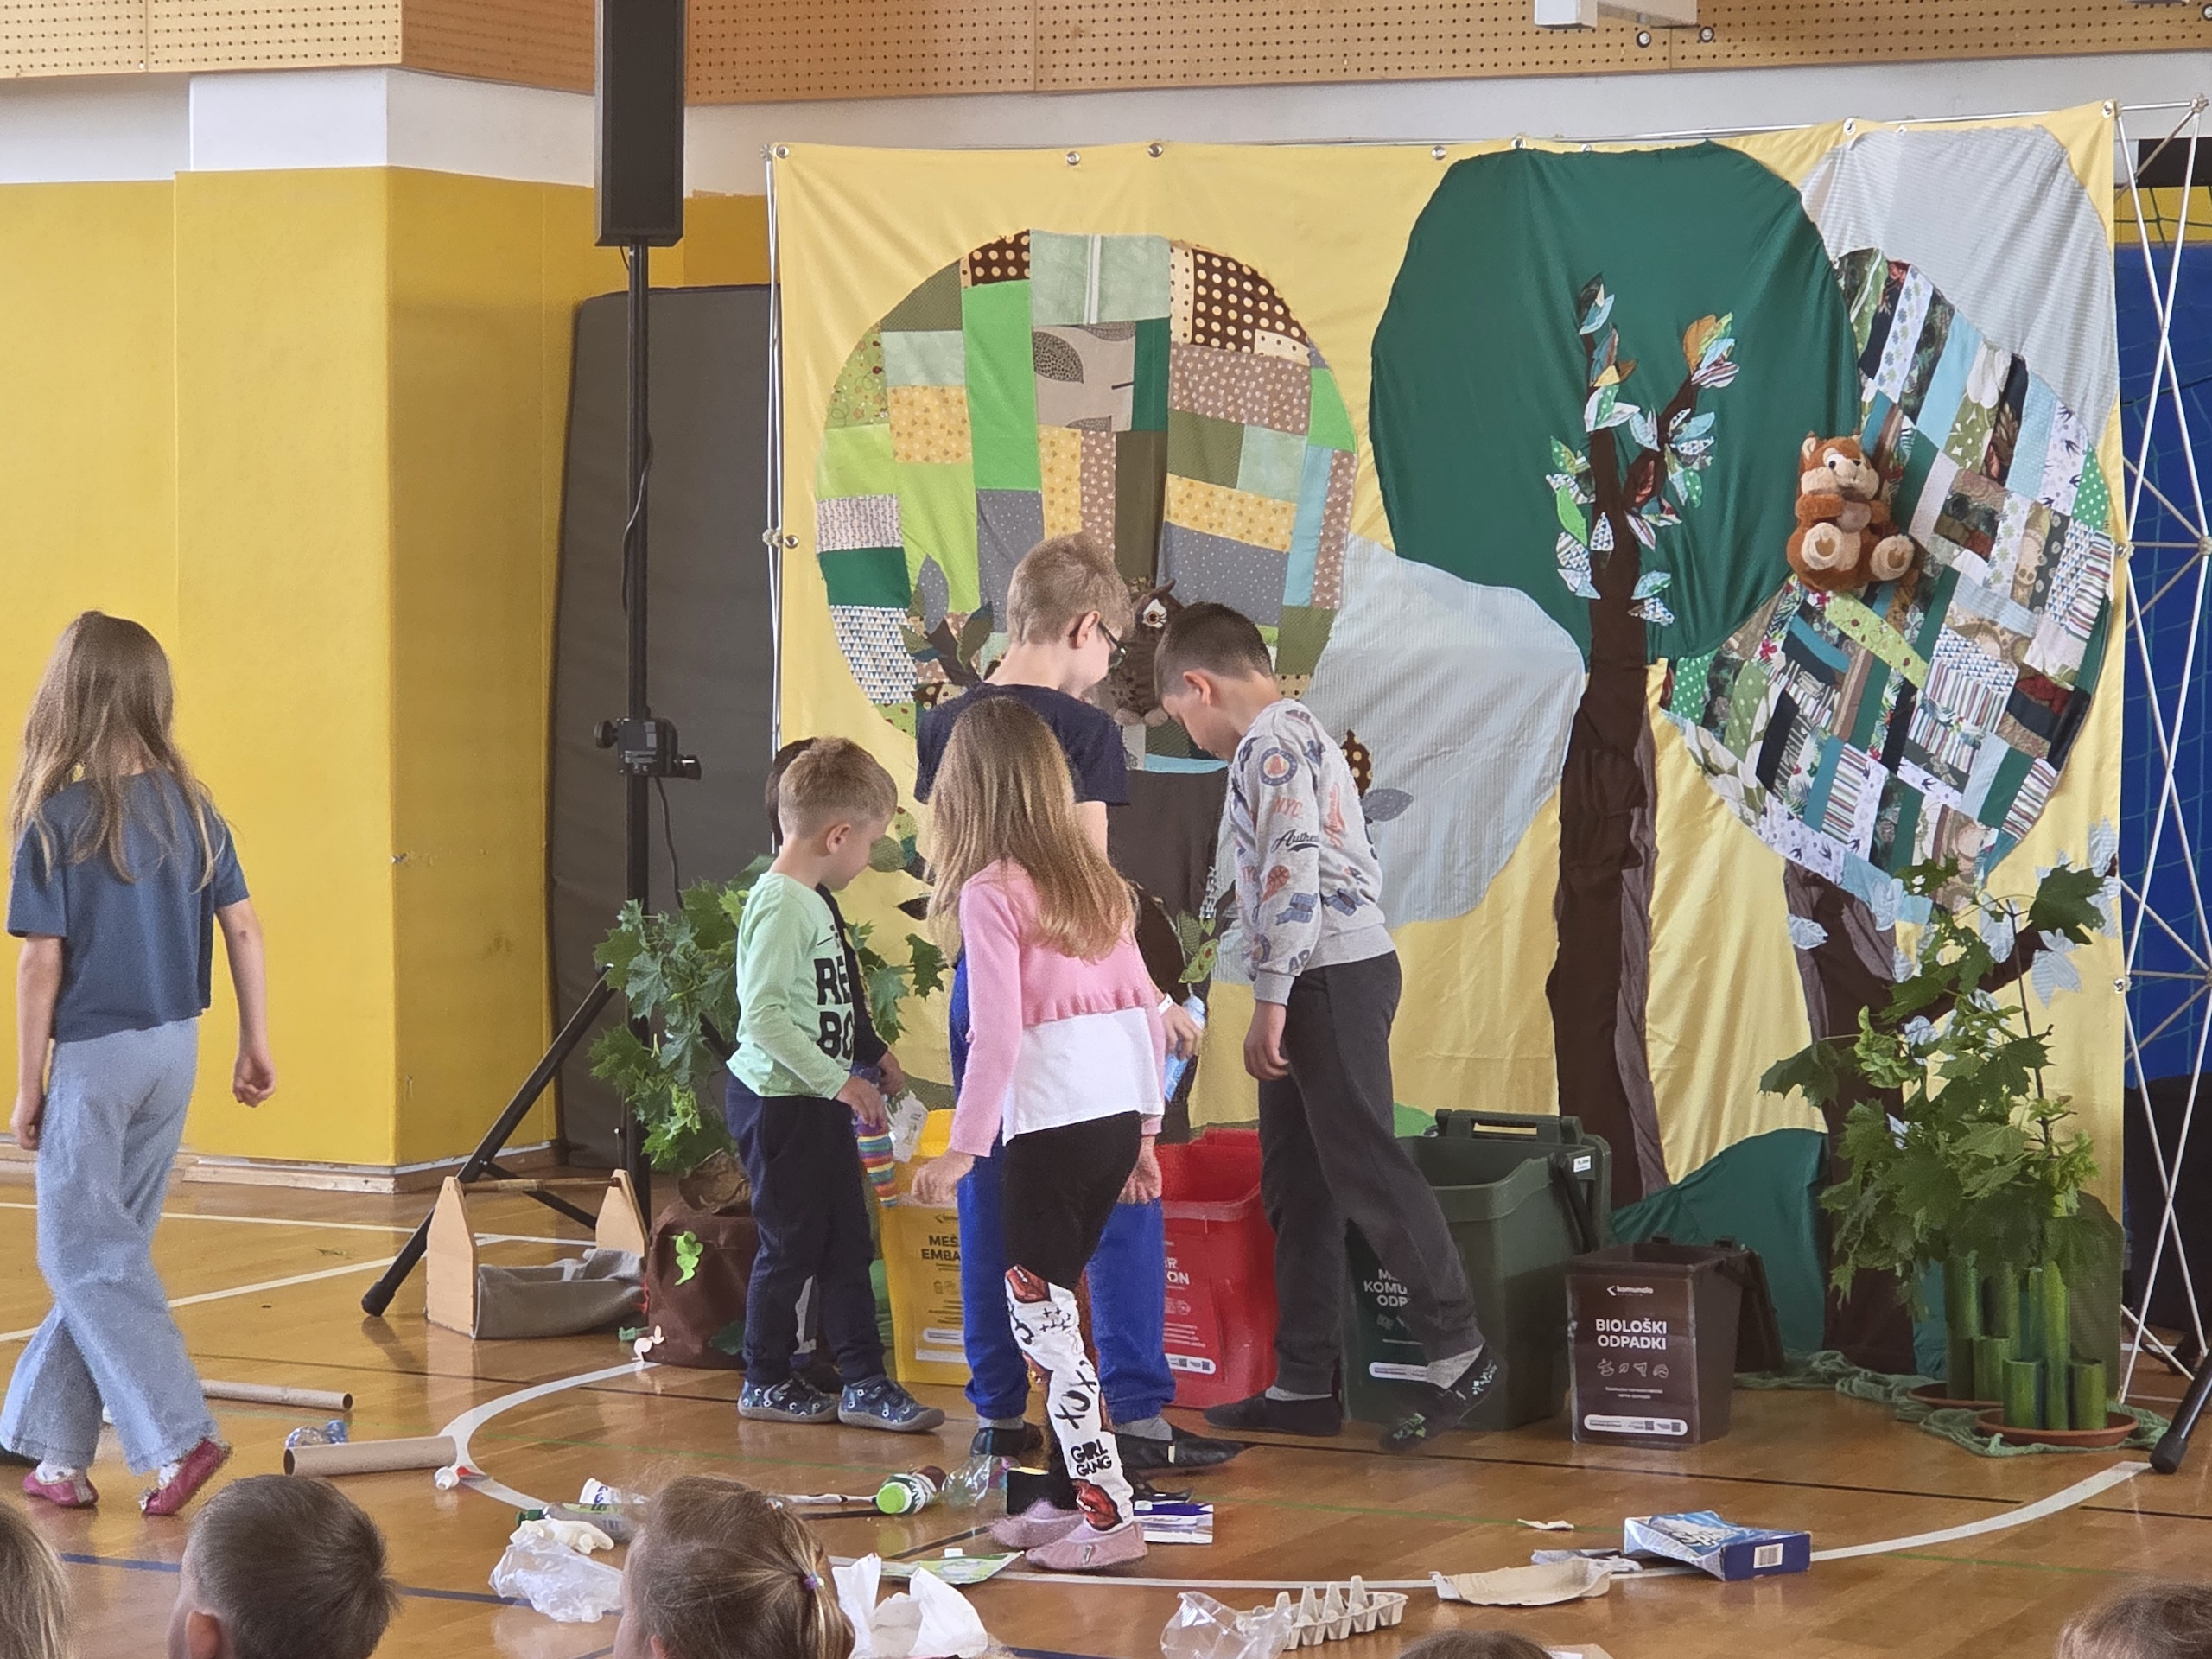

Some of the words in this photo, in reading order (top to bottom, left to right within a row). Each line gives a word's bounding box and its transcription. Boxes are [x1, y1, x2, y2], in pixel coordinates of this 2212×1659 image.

[928, 1233, 960, 1247] MEŠ
[921, 1248, 961, 1262] EMBA
[1166, 1270, 1190, 1285] ON
[1363, 1280, 1408, 1294] KOMU
[1376, 1294, 1408, 1307] ODP
[1595, 1317, 1668, 1334] BIOLOŠKI
[1597, 1334, 1667, 1350] ODPADKI
[1077, 1455, 1112, 1477] GANG
